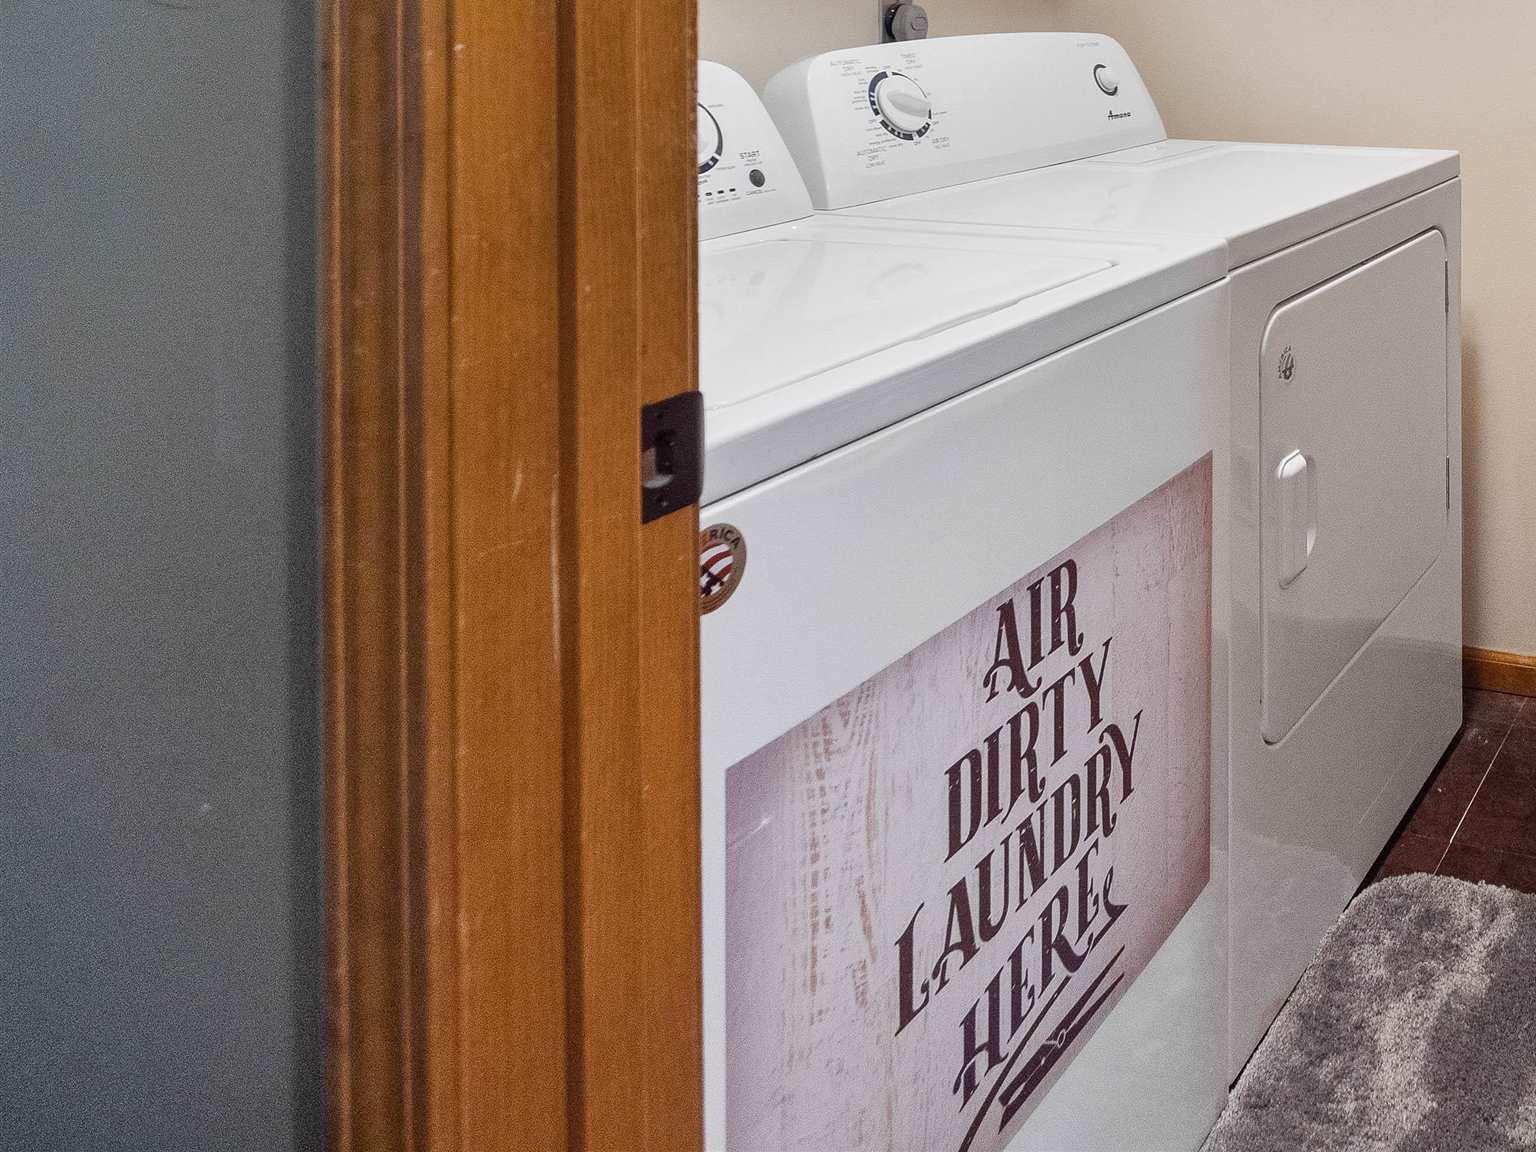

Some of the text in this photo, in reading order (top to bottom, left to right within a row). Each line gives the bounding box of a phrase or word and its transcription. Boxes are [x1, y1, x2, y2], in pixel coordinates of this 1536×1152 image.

[944, 637, 1113, 863] DIRTY
[983, 558, 1084, 703] AIR
[895, 709, 1143, 1037] LAUNDRY
[953, 838, 1100, 1113] HERE
